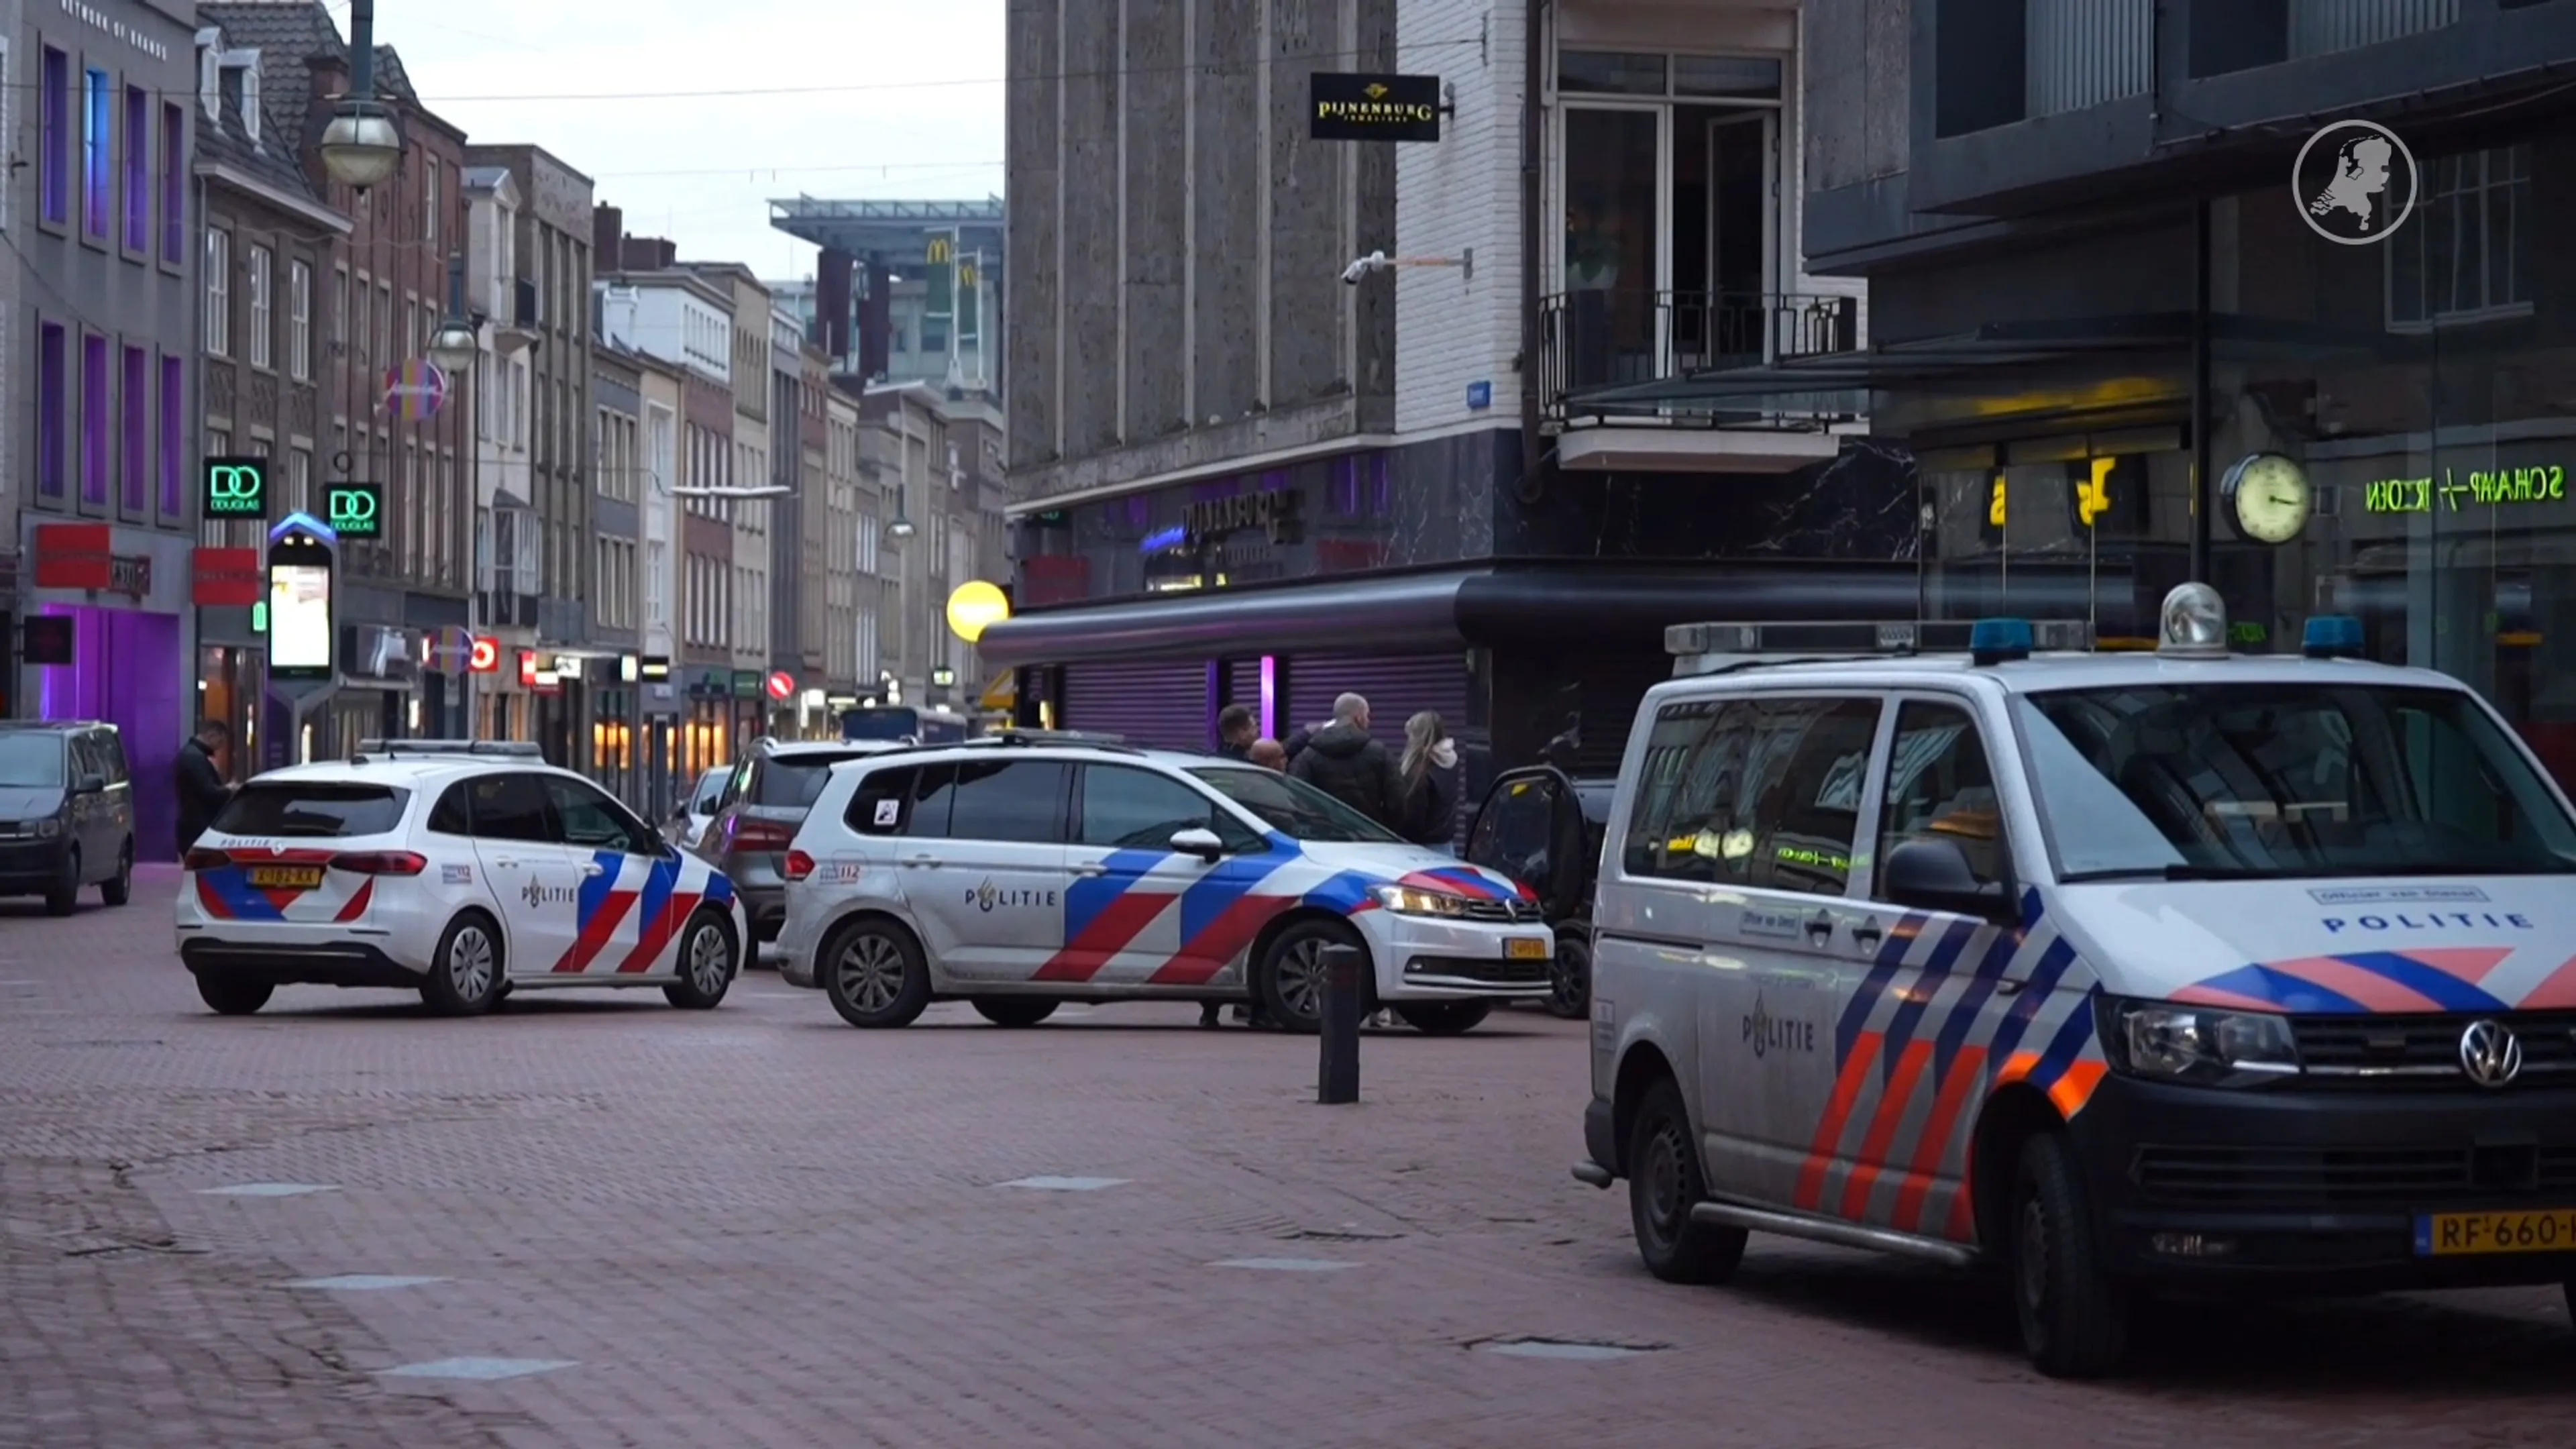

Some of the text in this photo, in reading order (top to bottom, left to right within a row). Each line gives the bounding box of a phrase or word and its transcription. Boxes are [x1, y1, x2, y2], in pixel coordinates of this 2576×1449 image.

[1318, 101, 1433, 121] PIJNENBURG
[210, 499, 260, 512] DOUGLAS
[219, 838, 270, 847] POLITIE
[841, 867, 861, 879] 112
[521, 886, 575, 908] POLITIE
[965, 888, 1057, 912] POLITIE
[2321, 913, 2534, 934] POLITIE
[1742, 1014, 1814, 1060] POLITIE
